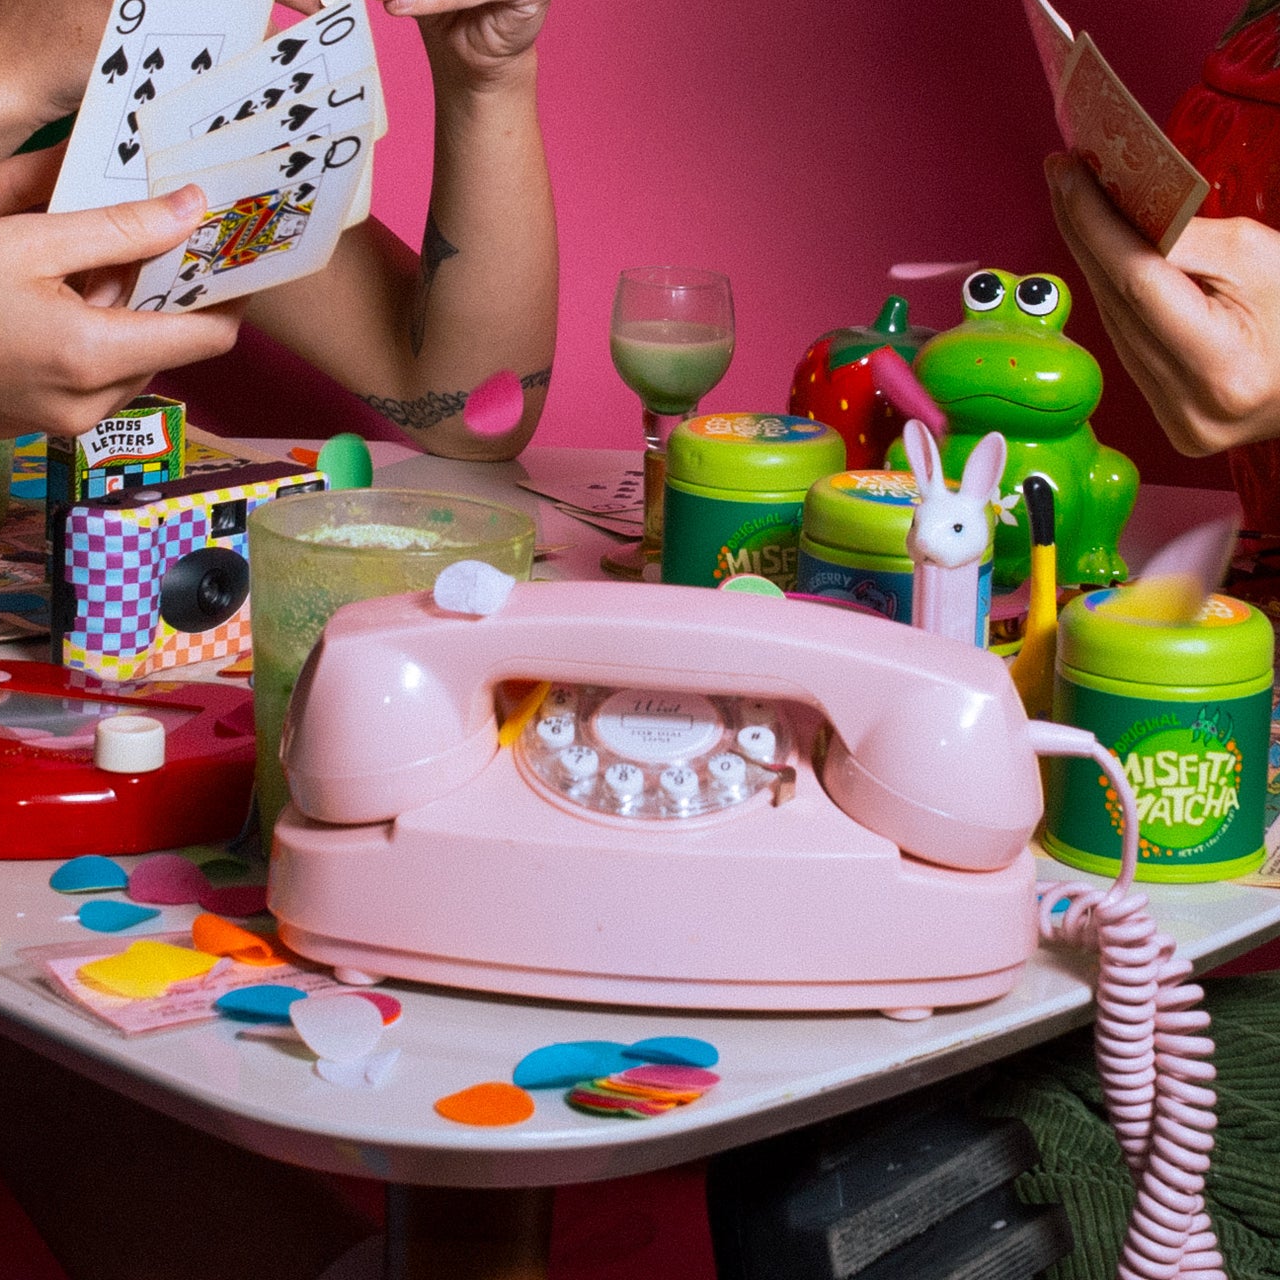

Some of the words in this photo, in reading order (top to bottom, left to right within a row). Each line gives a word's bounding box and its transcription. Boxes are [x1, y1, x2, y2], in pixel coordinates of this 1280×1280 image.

[316, 3, 356, 46] 10
[328, 86, 365, 109] J
[321, 135, 362, 174] Q
[95, 419, 142, 436] CROSS
[91, 432, 155, 453] LETTERS
[108, 446, 144, 455] GAME
[727, 512, 783, 549] ORIGINAL
[551, 724, 561, 735] 6
[1113, 712, 1181, 753] ORIGINAL
[618, 770, 629, 781] 8
[1114, 750, 1237, 793] MISFIT!
